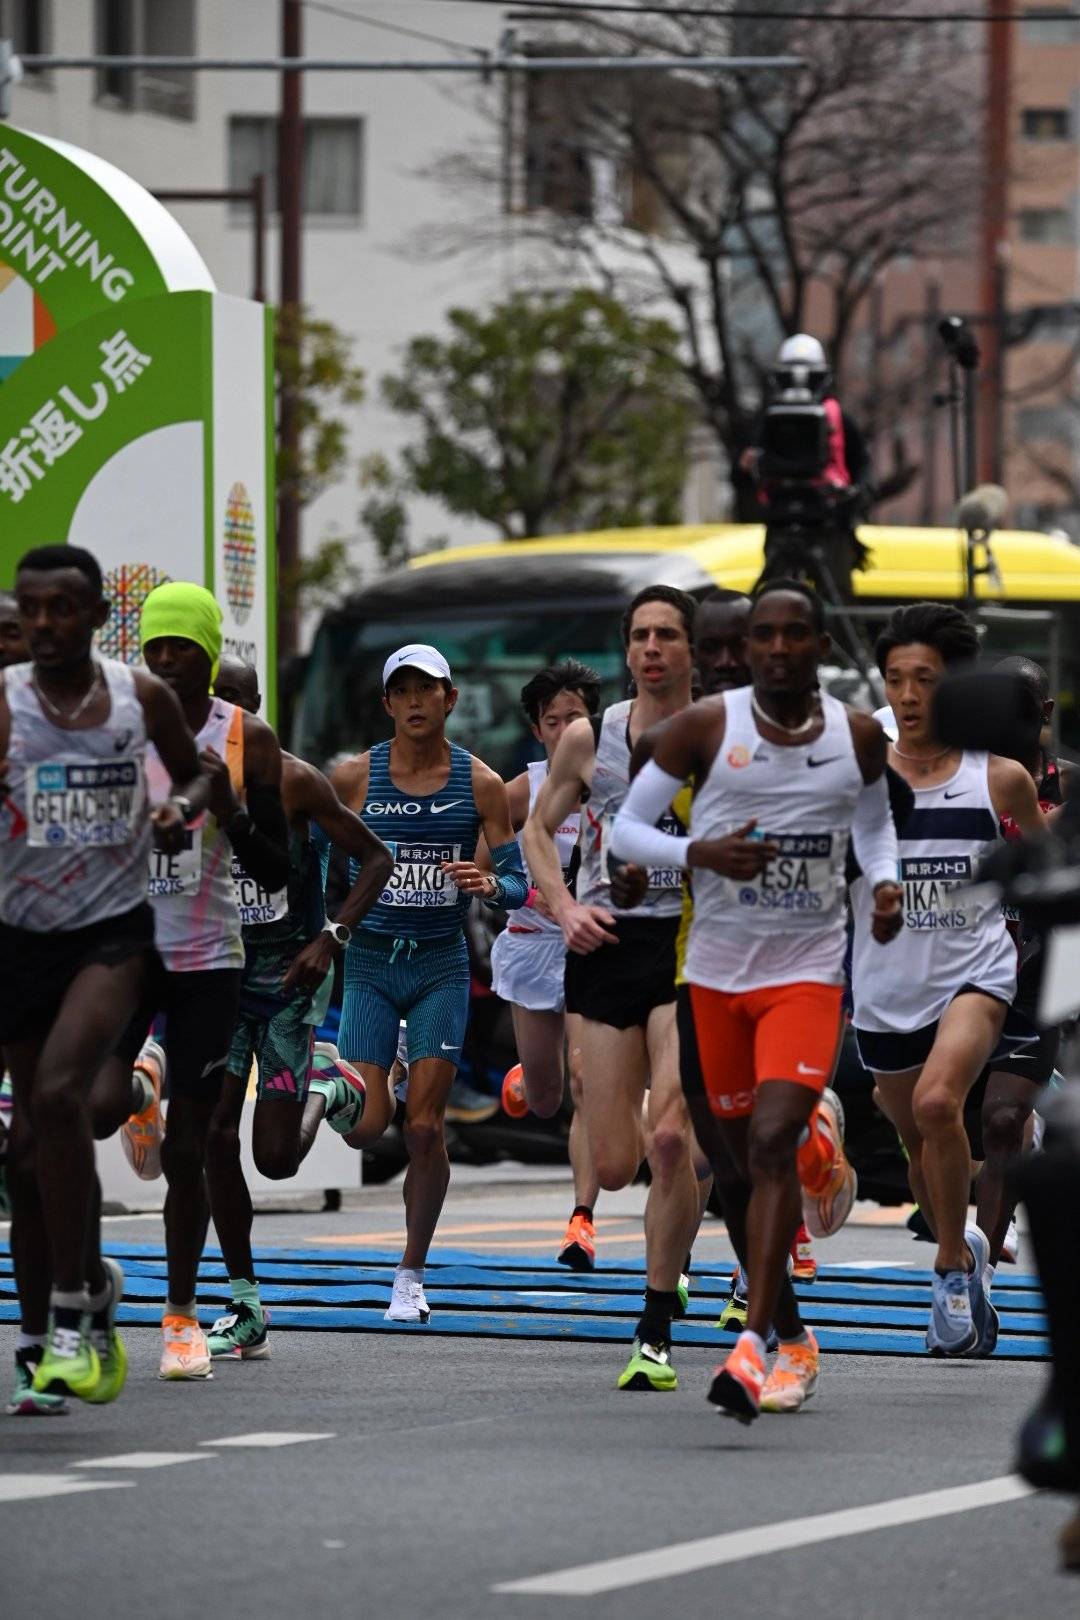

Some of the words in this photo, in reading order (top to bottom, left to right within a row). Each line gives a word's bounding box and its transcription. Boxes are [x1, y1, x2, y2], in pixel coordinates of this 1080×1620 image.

[0, 147, 135, 303] TURNING
[0, 328, 152, 503] 折返し点
[366, 802, 422, 815] GMO
[400, 849, 450, 860] 東京メトロ
[389, 864, 446, 891] SAKO
[906, 862, 967, 876] 東京メトロ
